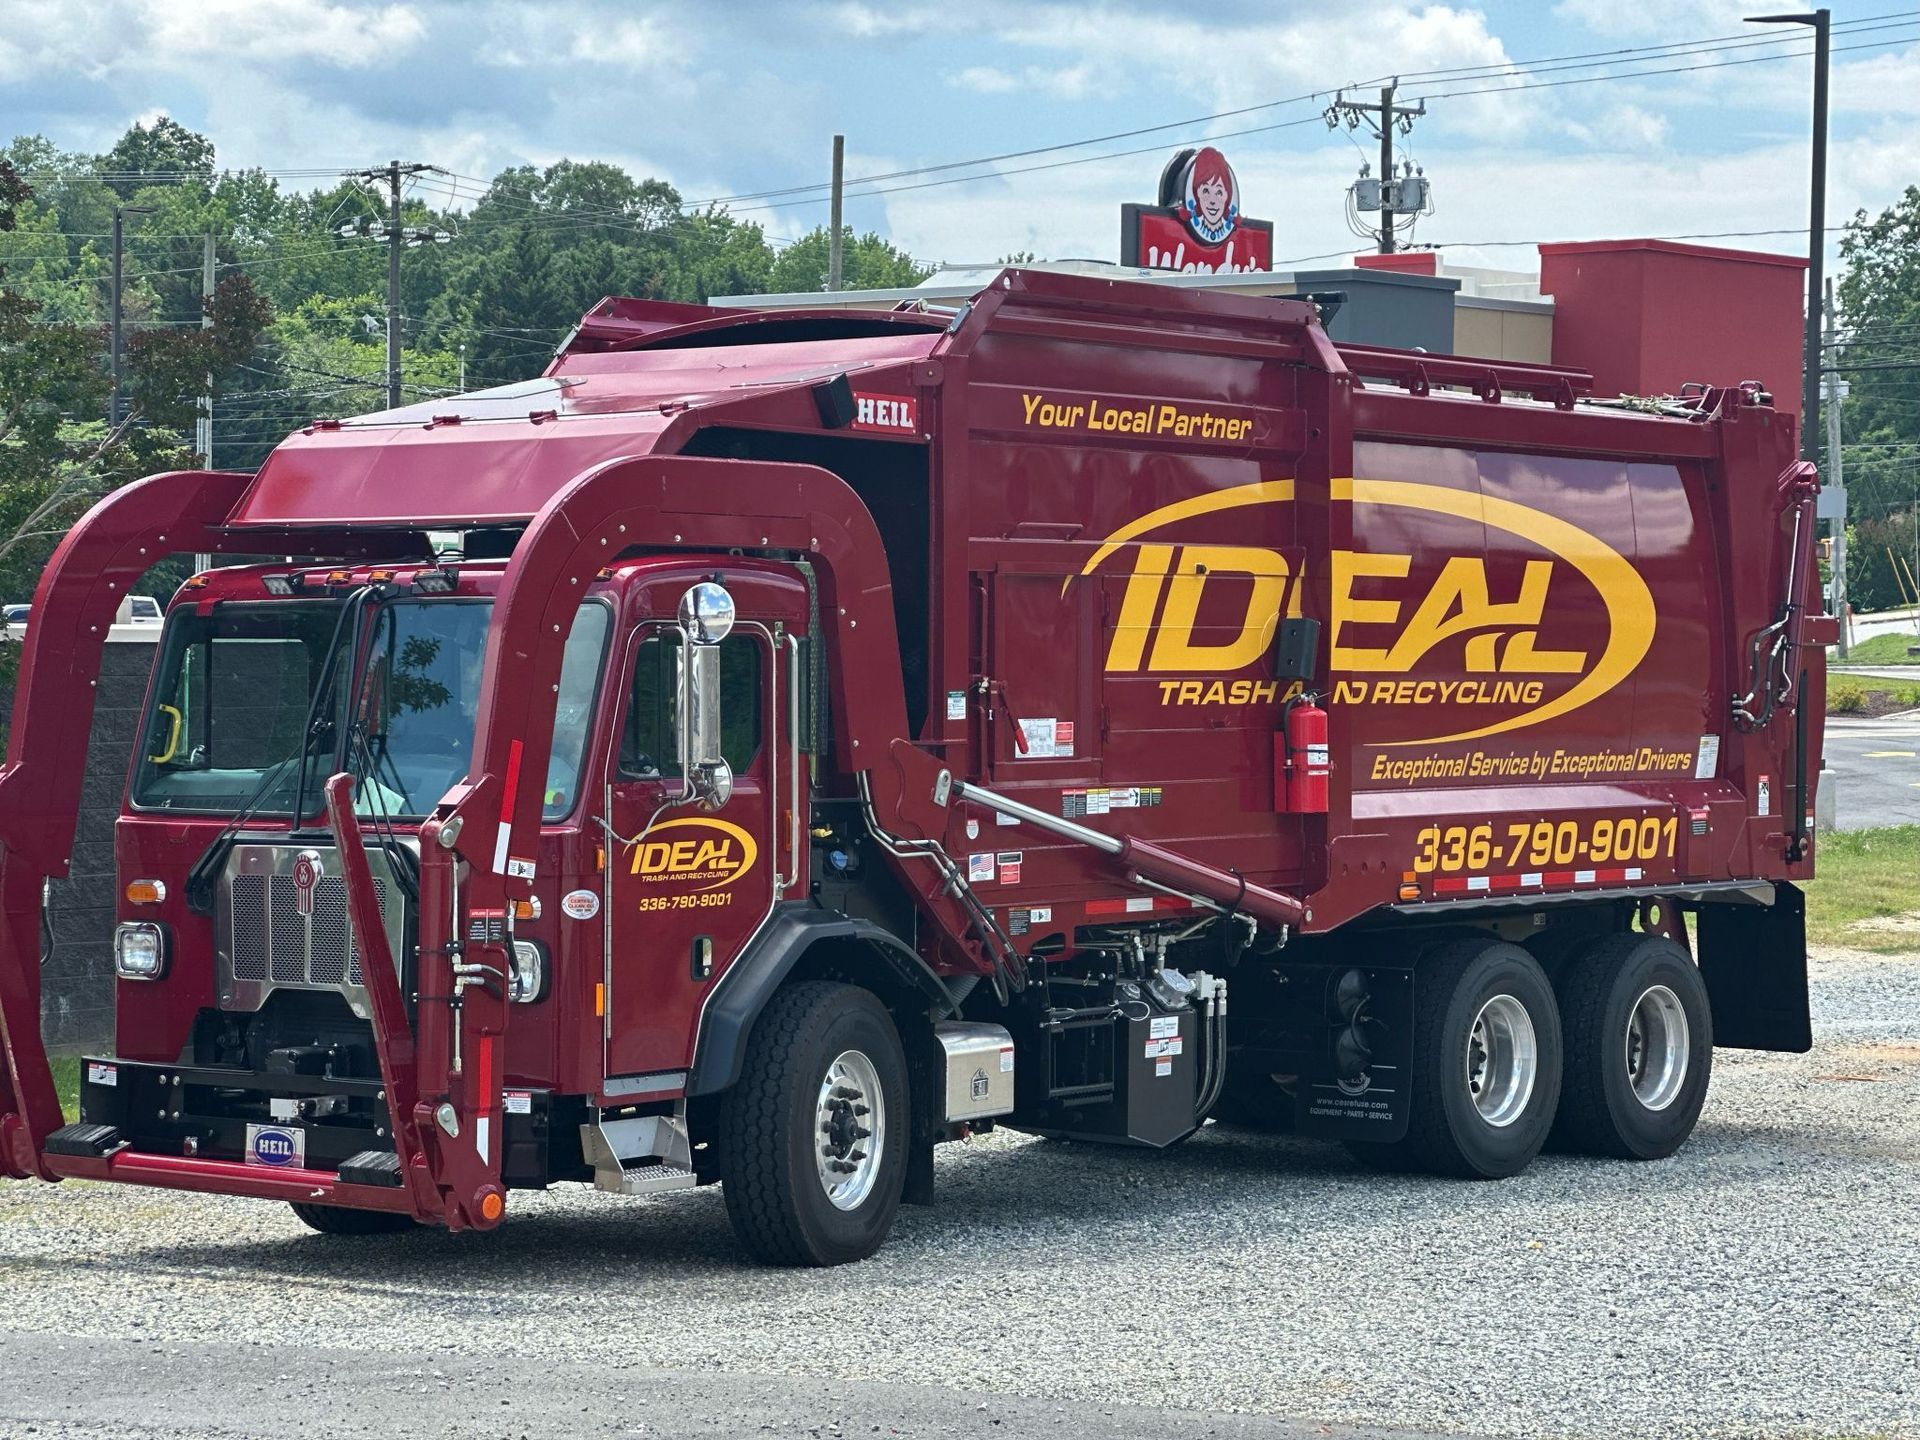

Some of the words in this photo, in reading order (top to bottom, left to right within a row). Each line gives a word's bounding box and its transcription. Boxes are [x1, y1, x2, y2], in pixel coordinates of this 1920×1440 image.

[857, 397, 914, 429] HEIL
[1022, 394, 1085, 427] Your
[1088, 399, 1156, 433] Local
[1158, 405, 1253, 440] Partner
[1104, 544, 1588, 674] IDEAL
[1159, 681, 1276, 706] TRASH
[1281, 680, 1368, 705] AND
[1371, 680, 1544, 704] RECYCLING
[1371, 752, 1470, 785] Exceptional
[1469, 751, 1529, 777] Service
[1530, 750, 1551, 781] by
[1550, 748, 1639, 779] Exceptional
[1637, 747, 1692, 771] Drivers
[631, 839, 740, 875] IDEAL
[1414, 816, 1678, 873] 336-790-9001
[642, 874, 669, 882] TRASH
[687, 870, 729, 879] RECYCLING
[639, 892, 732, 912] 336-790-9001
[1310, 1107, 1342, 1116] EQUIPMENT
[1346, 1110, 1364, 1118] PARTS
[1368, 1112, 1393, 1120] SERVICE
[258, 1138, 292, 1156] HEIL
